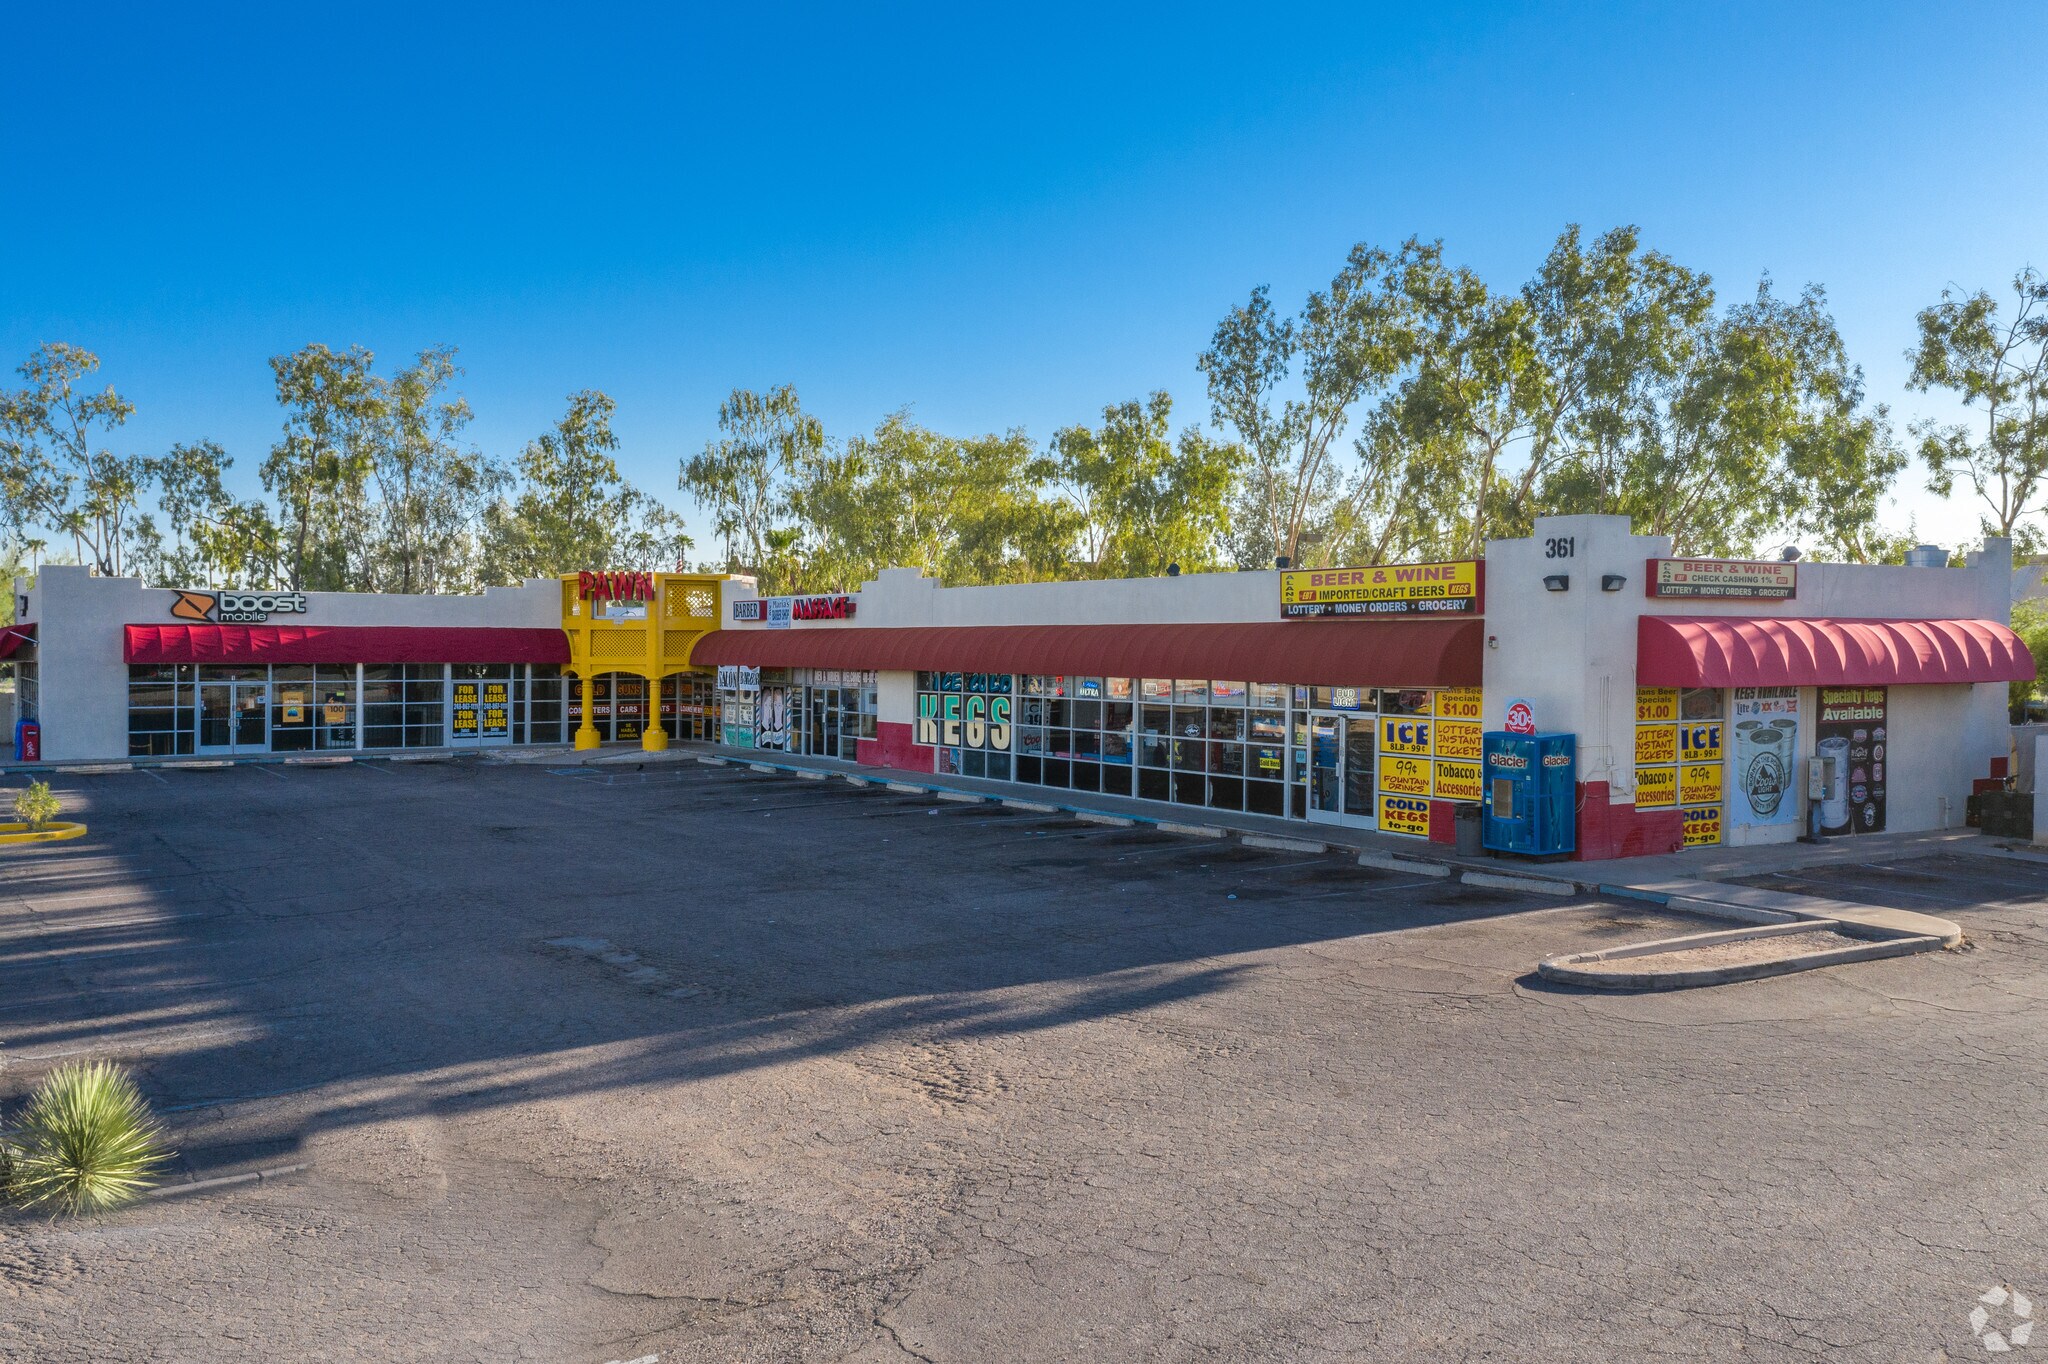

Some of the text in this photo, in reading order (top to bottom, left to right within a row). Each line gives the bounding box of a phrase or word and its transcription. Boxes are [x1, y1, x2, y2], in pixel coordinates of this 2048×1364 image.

[1545, 536, 1575, 558] 361
[1683, 563, 1781, 575] BEER & WINE
[1311, 566, 1456, 586] BEER & WINE
[1691, 574, 1720, 583] CHECK
[1722, 575, 1759, 584] CASHING
[1760, 576, 1772, 584] 1%
[578, 570, 655, 601] PAWN
[1662, 586, 1789, 597] LOTTERY MONEY ORDERS GROCERY
[1319, 587, 1405, 600] IMPORTED/CRAFT
[1409, 585, 1445, 597] BEERS
[1451, 584, 1469, 594] KEGS
[219, 592, 306, 612] boost
[1288, 600, 1467, 615] LOTTERY MONEY ORDERS GROCERY
[735, 603, 758, 618] BARBER
[791, 597, 849, 620] MASSAGE
[220, 612, 267, 621] mobile
[933, 672, 1012, 693] ICE COLD
[458, 685, 474, 694] FOR
[488, 685, 503, 694] FOR
[575, 684, 605, 696] GLD
[617, 683, 642, 696] GUNS
[1080, 687, 1099, 697] ULTRA
[1336, 688, 1356, 698] BUD
[1734, 686, 1755, 700] KEGS
[454, 694, 478, 703] LEASE
[484, 693, 507, 703] LEASE
[1333, 697, 1358, 706] LIGHT
[1442, 694, 1480, 702] Specials
[1637, 696, 1672, 704] Specials
[1823, 689, 1884, 705] Specialty Kegs
[458, 710, 474, 719] FOR
[488, 709, 503, 718] FOR
[568, 706, 611, 715] COTERS
[619, 705, 638, 713] CARS
[1443, 702, 1478, 716] $1.00
[1638, 705, 1670, 720] $1.00
[1823, 706, 1884, 721] Available
[484, 718, 507, 728] LEASE
[920, 694, 1011, 750] KEGS
[1508, 710, 1532, 726] 30¢
[454, 720, 478, 729] LEASE
[1387, 720, 1429, 746] ICE
[1635, 729, 1675, 740] OTTERY
[1681, 724, 1721, 749] ICE
[1438, 735, 1482, 747] INSTANT
[1390, 743, 1405, 751] 8LB
[1411, 744, 1426, 752] 99¢
[1438, 745, 1482, 757] TICKETS
[1684, 750, 1698, 758] 8LB
[1704, 749, 1717, 758] 99¢
[1489, 753, 1528, 768] Glacier
[1543, 755, 1571, 767] Glacier
[1396, 760, 1418, 775] 99¢
[1437, 763, 1475, 779] Tobacco
[1383, 775, 1430, 786] FOUNTAIN
[1690, 767, 1710, 783] 99¢
[1388, 783, 1425, 793] DRINKS
[1680, 785, 1721, 793] FOUNTAIN
[1635, 786, 1675, 803] ccessories
[1683, 792, 1716, 801] DRINKS
[1386, 799, 1428, 811] COLD
[1385, 810, 1428, 823] KEGS
[1388, 821, 1424, 832] to-go
